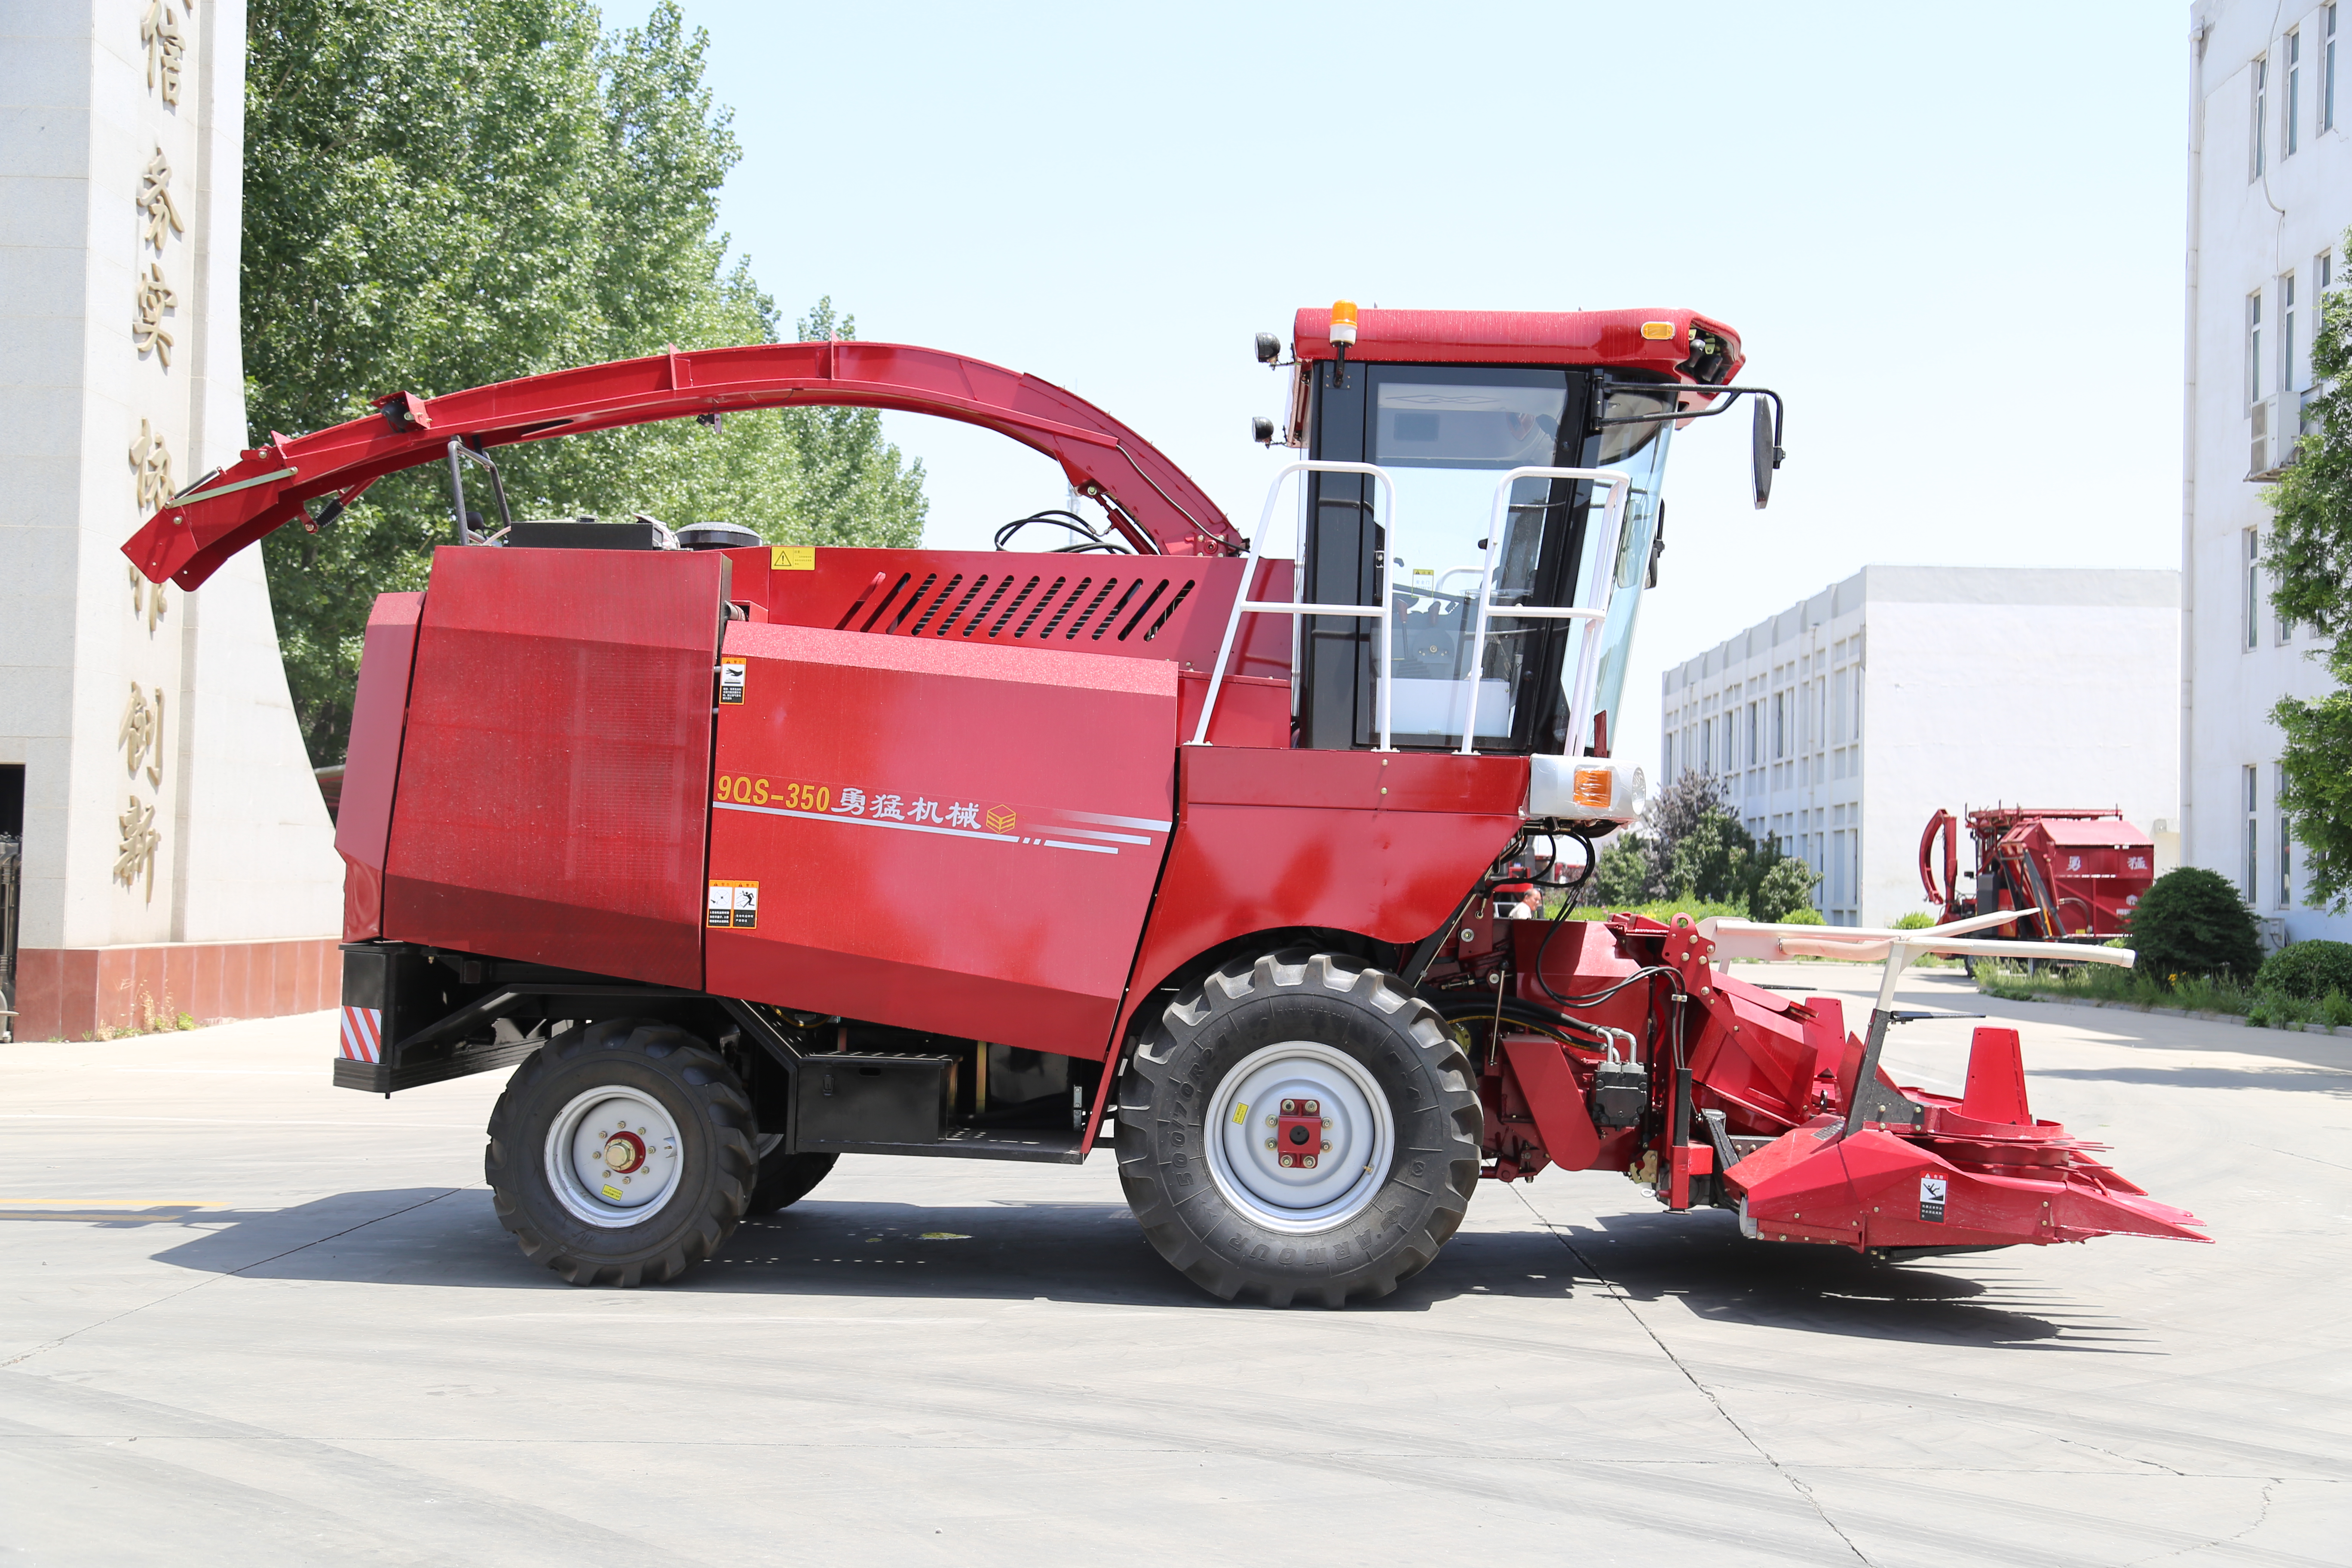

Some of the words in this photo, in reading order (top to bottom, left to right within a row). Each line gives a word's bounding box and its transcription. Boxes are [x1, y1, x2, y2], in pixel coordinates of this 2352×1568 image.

[717, 775, 830, 812] 9QS-350
[831, 787, 982, 830] 勇猛机械
[1228, 1228, 1372, 1265] ARMOUR
